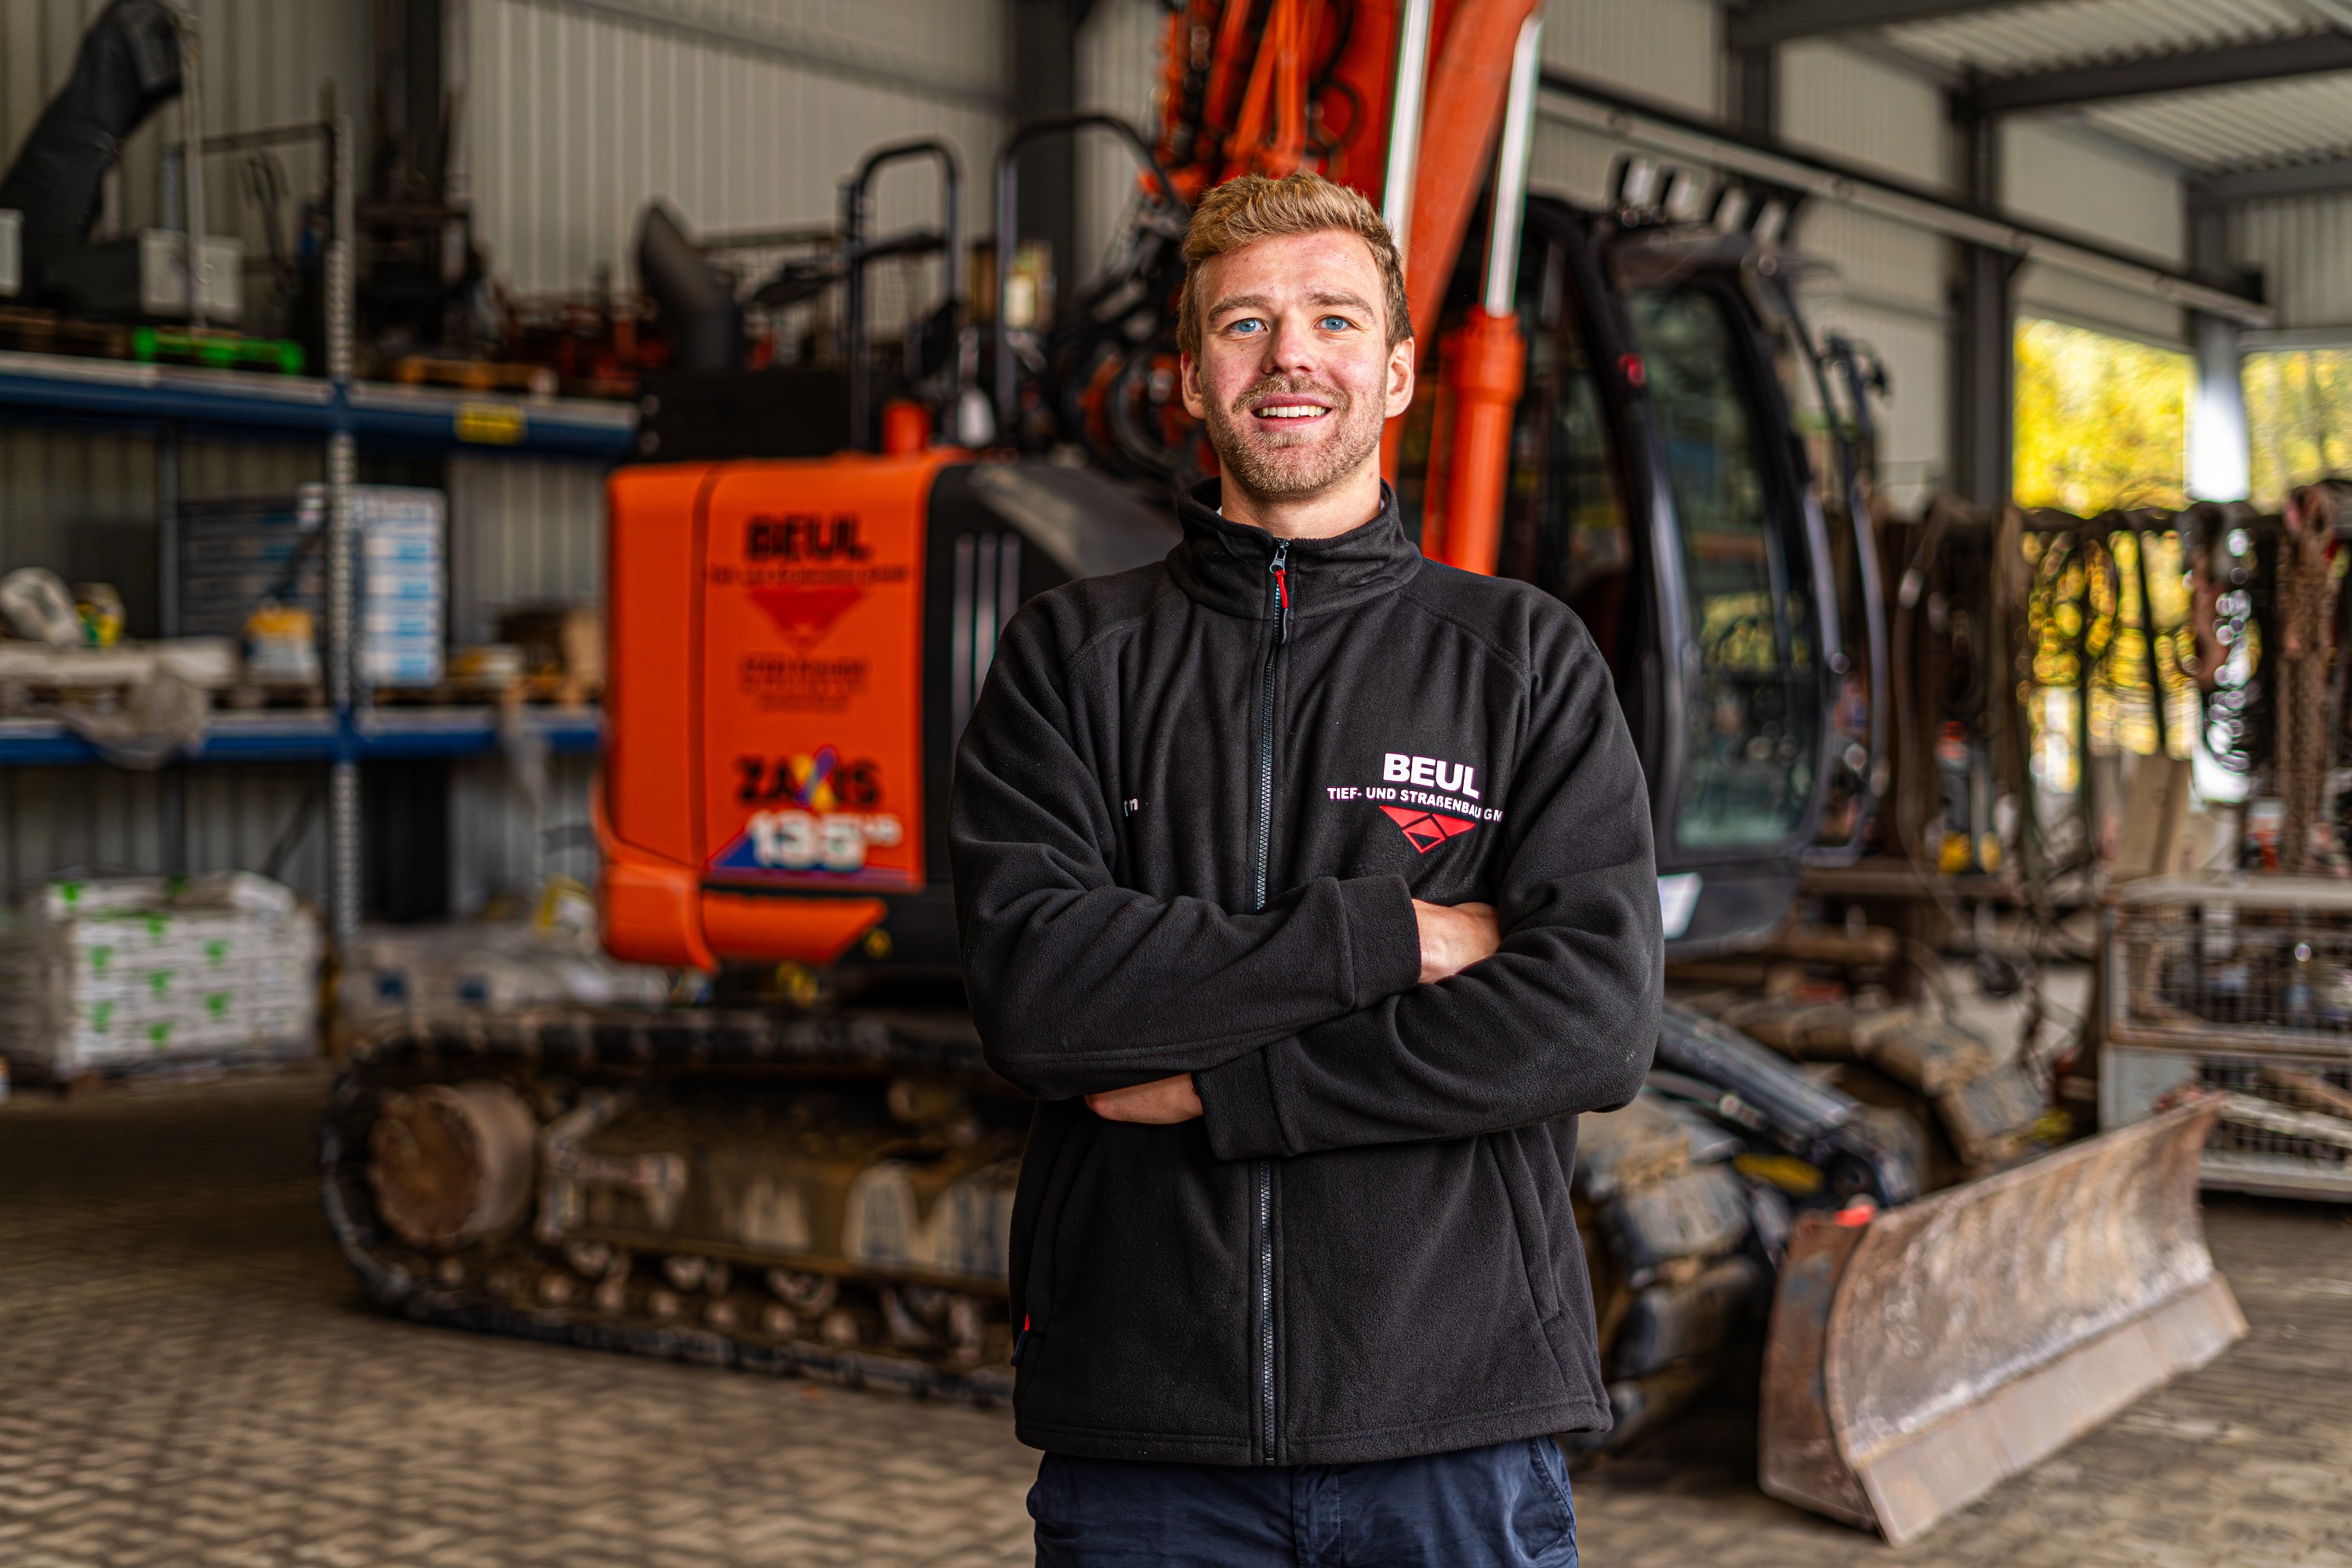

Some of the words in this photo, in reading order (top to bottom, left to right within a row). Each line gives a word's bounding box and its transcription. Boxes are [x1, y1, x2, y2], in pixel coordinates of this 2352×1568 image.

[746, 515, 872, 561] BEUL
[1382, 753, 1479, 799] BEUL
[1327, 787, 1362, 800] TIEF-
[1366, 787, 1396, 800] UND
[1399, 789, 1482, 818] STRAßENBAU
